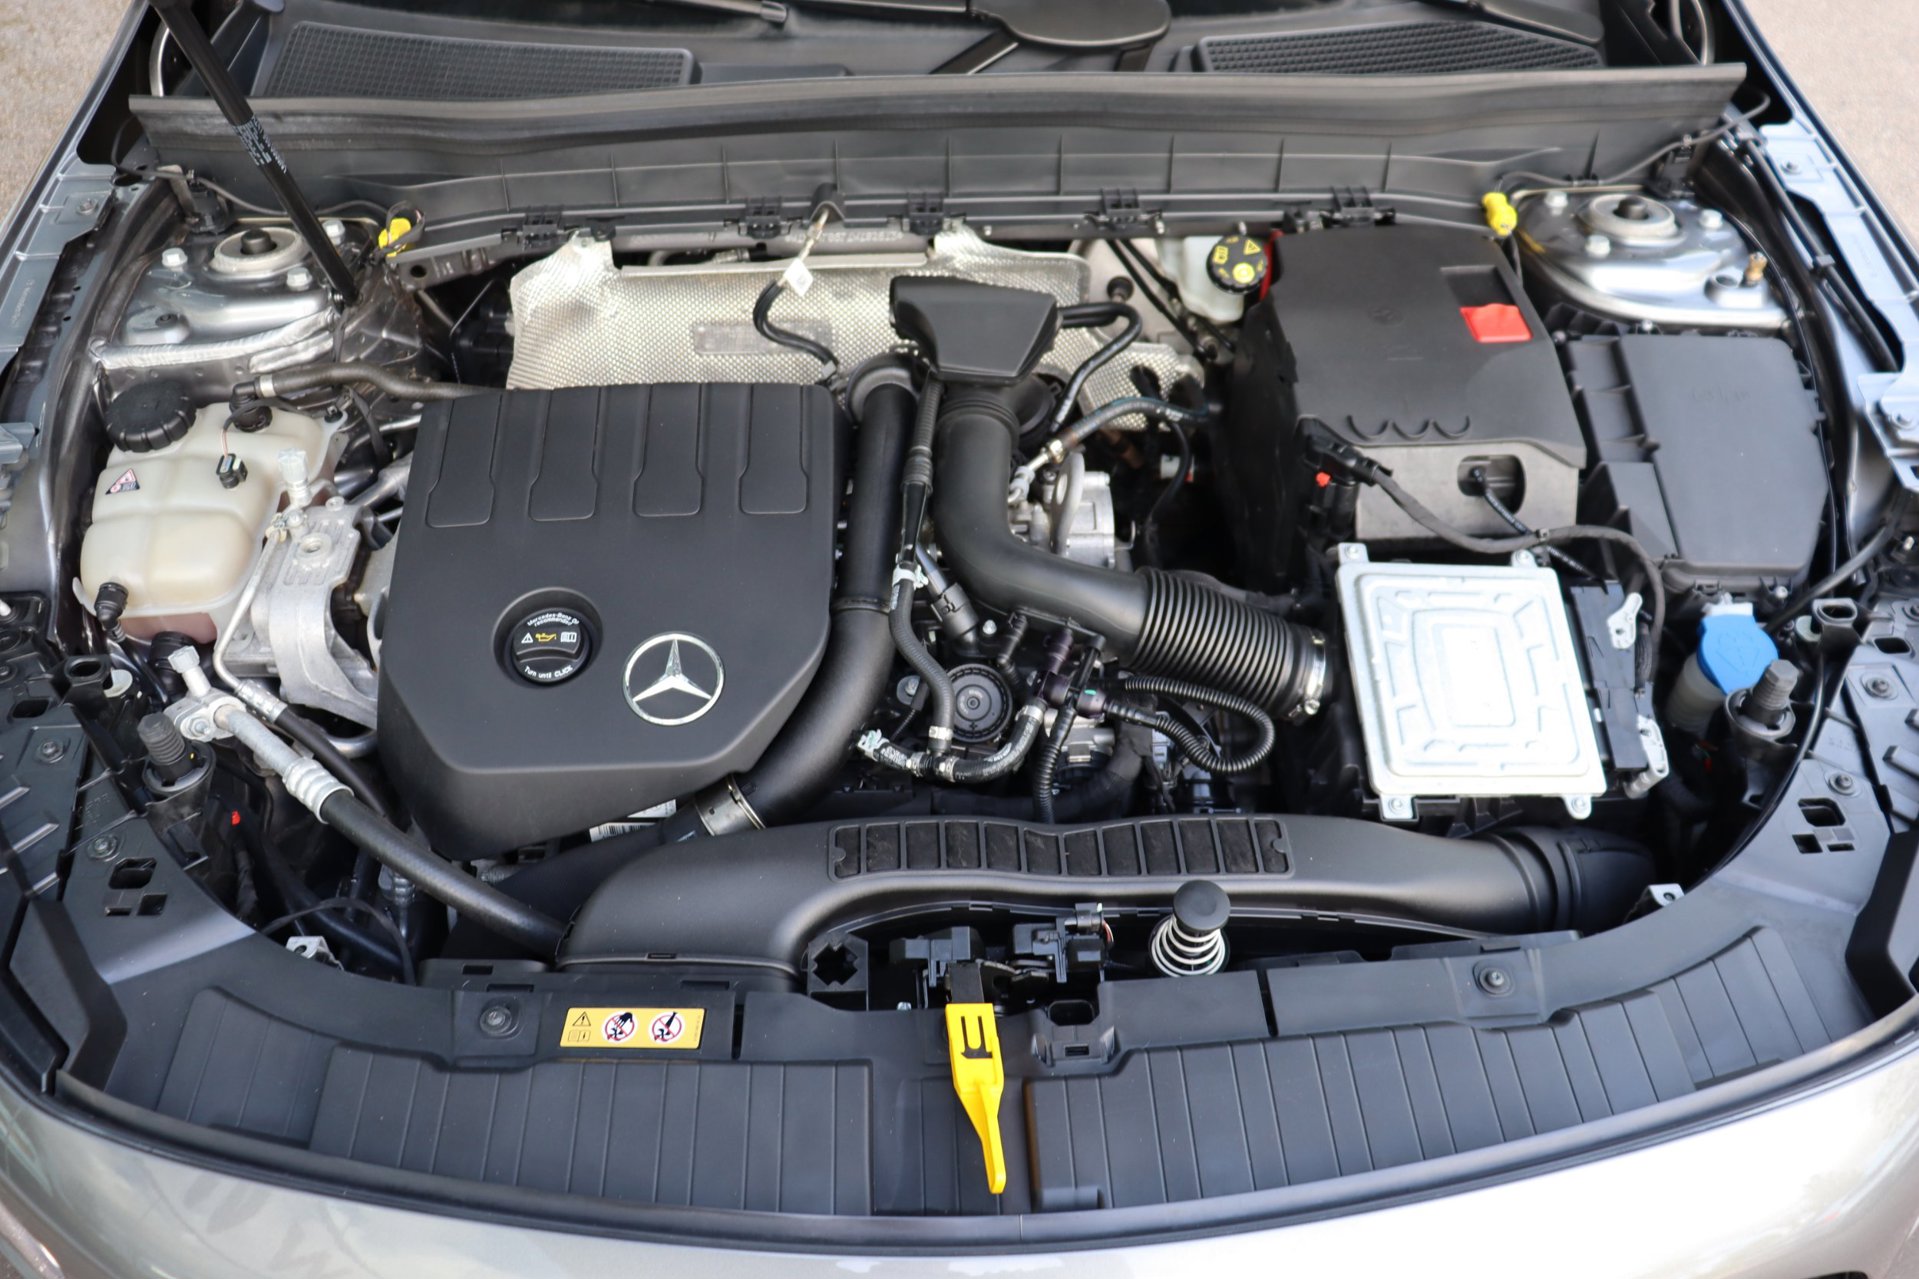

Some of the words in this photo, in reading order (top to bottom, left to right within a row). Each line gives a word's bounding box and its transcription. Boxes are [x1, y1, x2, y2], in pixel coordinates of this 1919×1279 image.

[524, 665, 536, 677] Turn
[538, 671, 552, 679] until
[554, 665, 573, 677] CLICK
